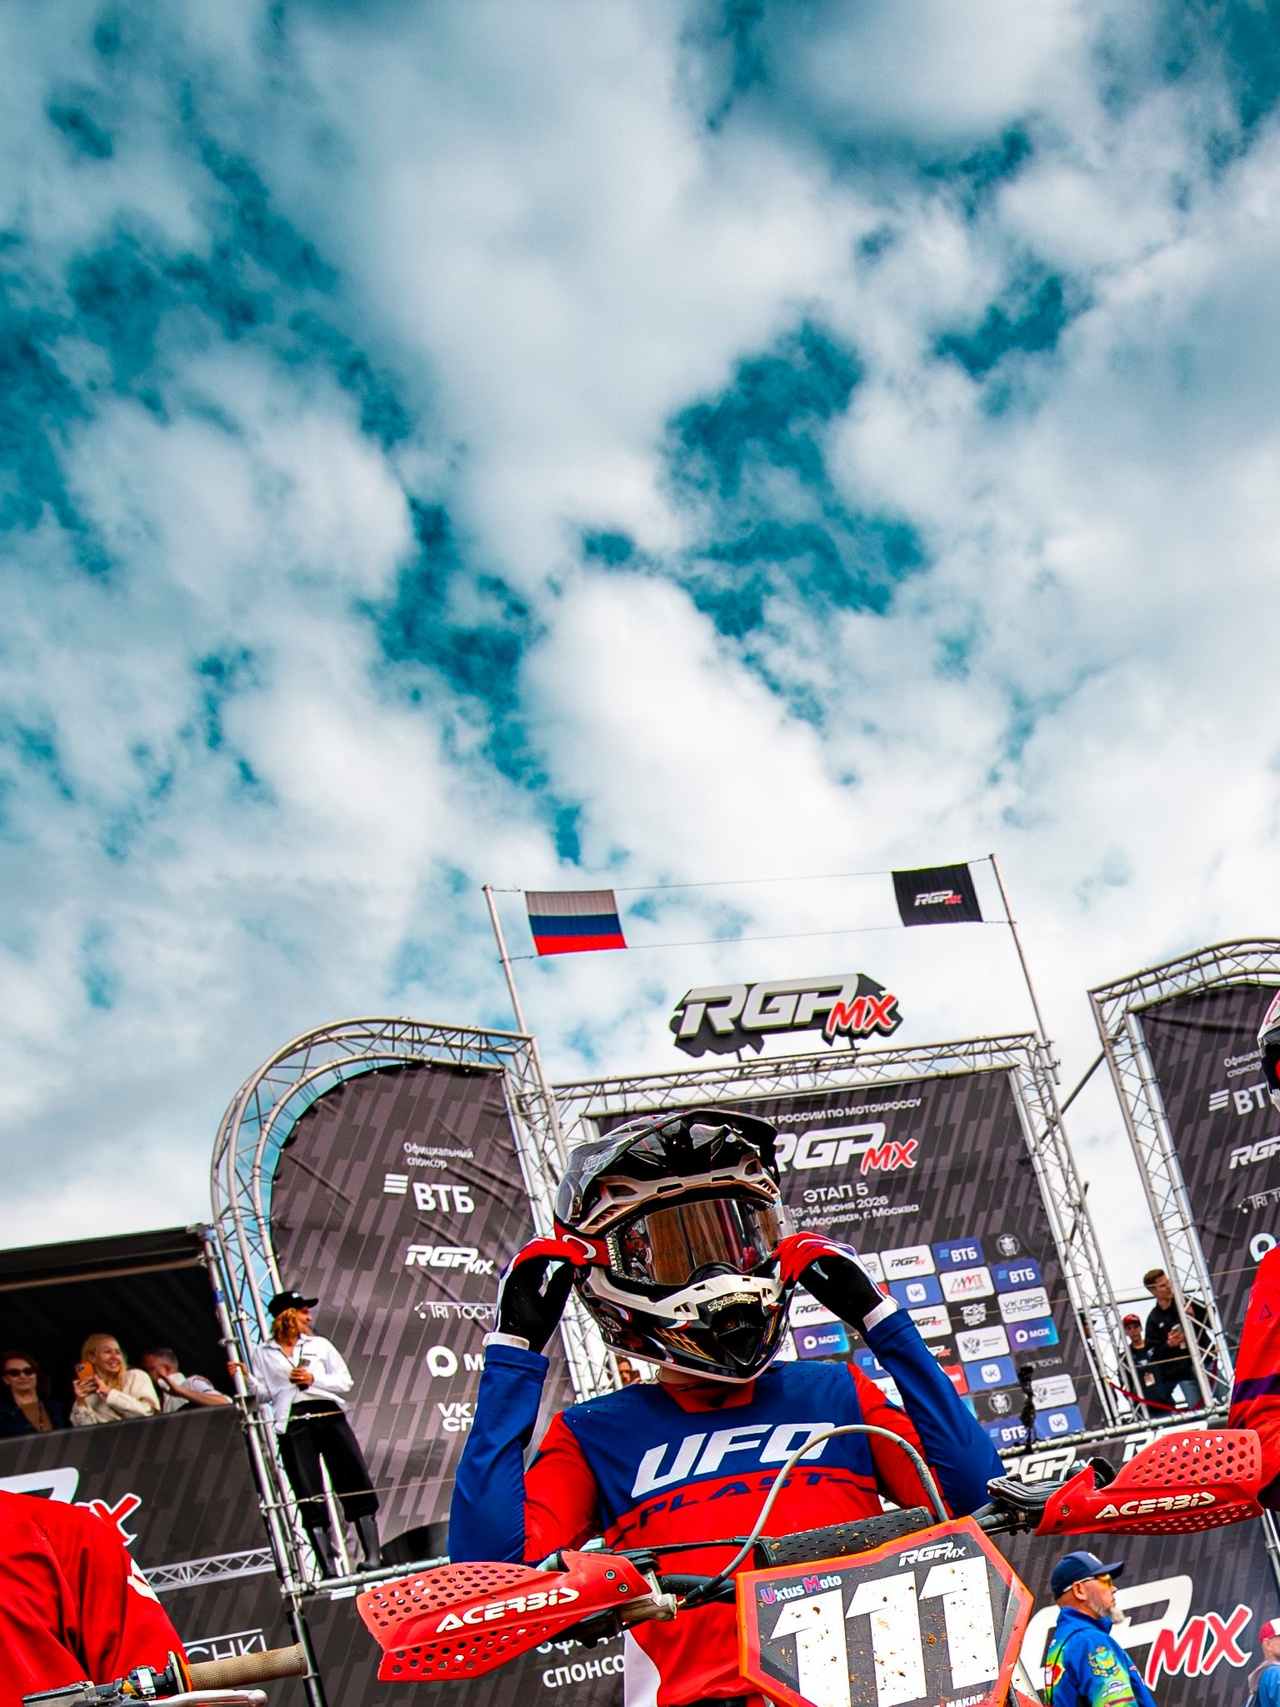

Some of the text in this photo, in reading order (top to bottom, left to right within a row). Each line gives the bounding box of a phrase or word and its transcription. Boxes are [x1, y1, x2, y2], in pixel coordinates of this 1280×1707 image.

[679, 973, 899, 1040] RGP MX
[828, 1108, 845, 1118] ПО
[1233, 1082, 1270, 1116] ВТ
[860, 1138, 919, 1175] MX
[412, 1182, 475, 1214] ВТБ
[803, 1182, 869, 1203] ЭТАП 5
[405, 1244, 479, 1268] RGP
[950, 1246, 978, 1263] ВТБ
[1008, 1267, 1036, 1284] ВТБ
[437, 1402, 472, 1418] VK
[631, 1422, 836, 1498] UFO
[1095, 1491, 1216, 1519] ACERBIS
[899, 1542, 954, 1567] RGP
[803, 1574, 843, 1596] Moto
[436, 1587, 580, 1634] ACERBIS
[768, 1555, 999, 1707] 111
[1144, 1603, 1253, 1692] MX
[541, 1654, 626, 1689] СПОНСО
